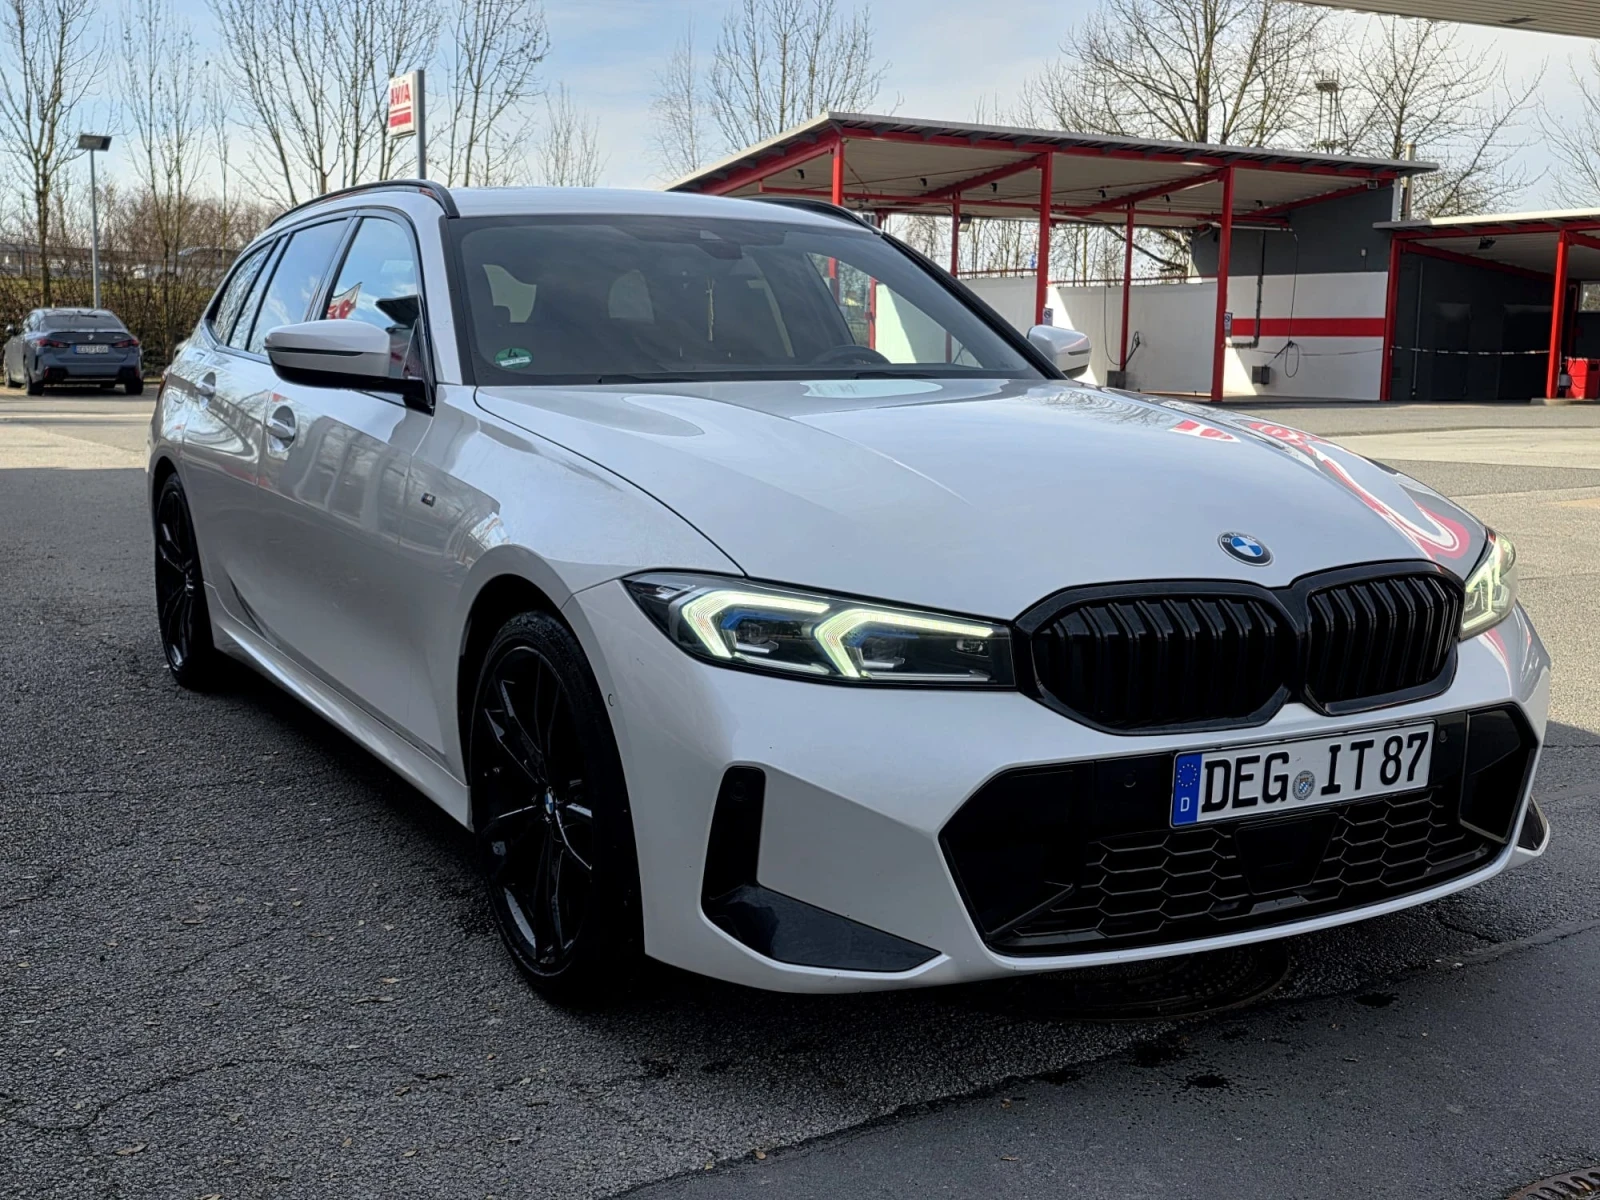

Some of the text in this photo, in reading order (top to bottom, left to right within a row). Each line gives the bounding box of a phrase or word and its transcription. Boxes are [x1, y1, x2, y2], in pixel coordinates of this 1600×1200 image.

[390, 83, 411, 107] AVIA
[1201, 751, 1290, 813] DEG
[1320, 739, 1374, 796] IT
[1379, 731, 1429, 786] 87
[1180, 797, 1190, 812] D
